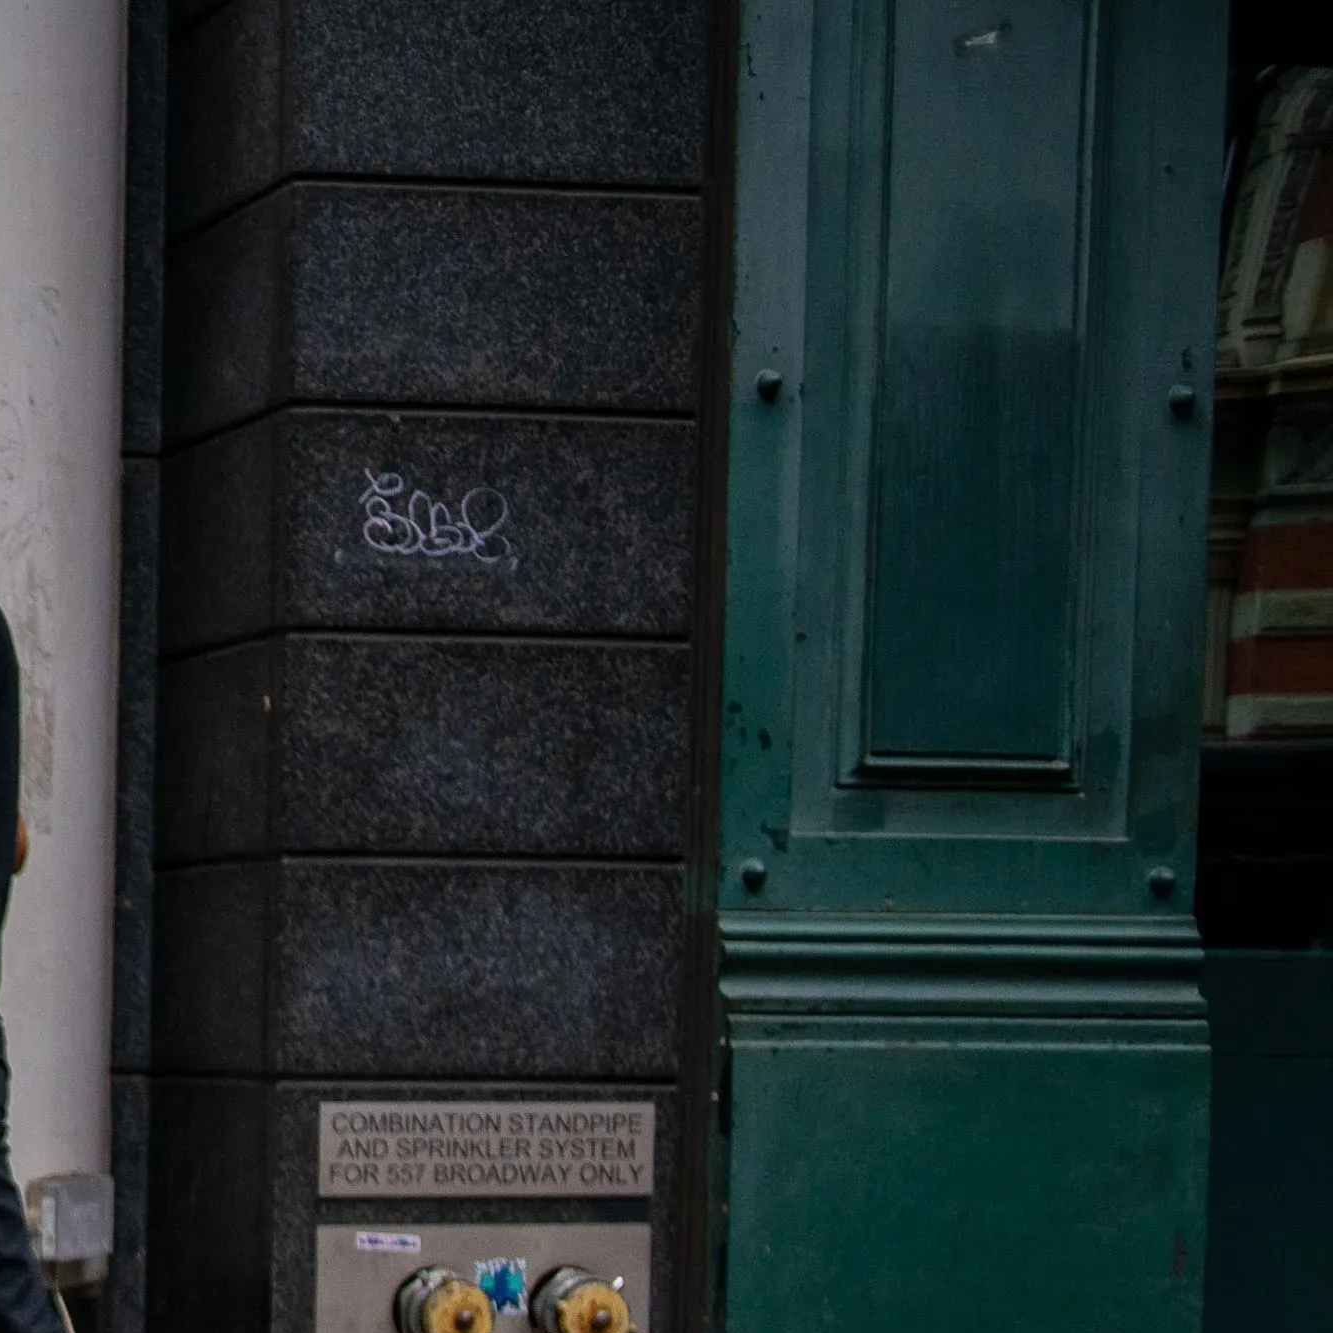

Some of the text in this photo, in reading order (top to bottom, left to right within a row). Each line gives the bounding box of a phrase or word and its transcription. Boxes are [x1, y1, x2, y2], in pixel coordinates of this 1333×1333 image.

[332, 1111, 643, 1135] COMBINATION STANDPIPE
[336, 1137, 636, 1160] AND SPRINKLER SYSTEM
[329, 1162, 644, 1185] FOR 557 BROADWAY ONLY
